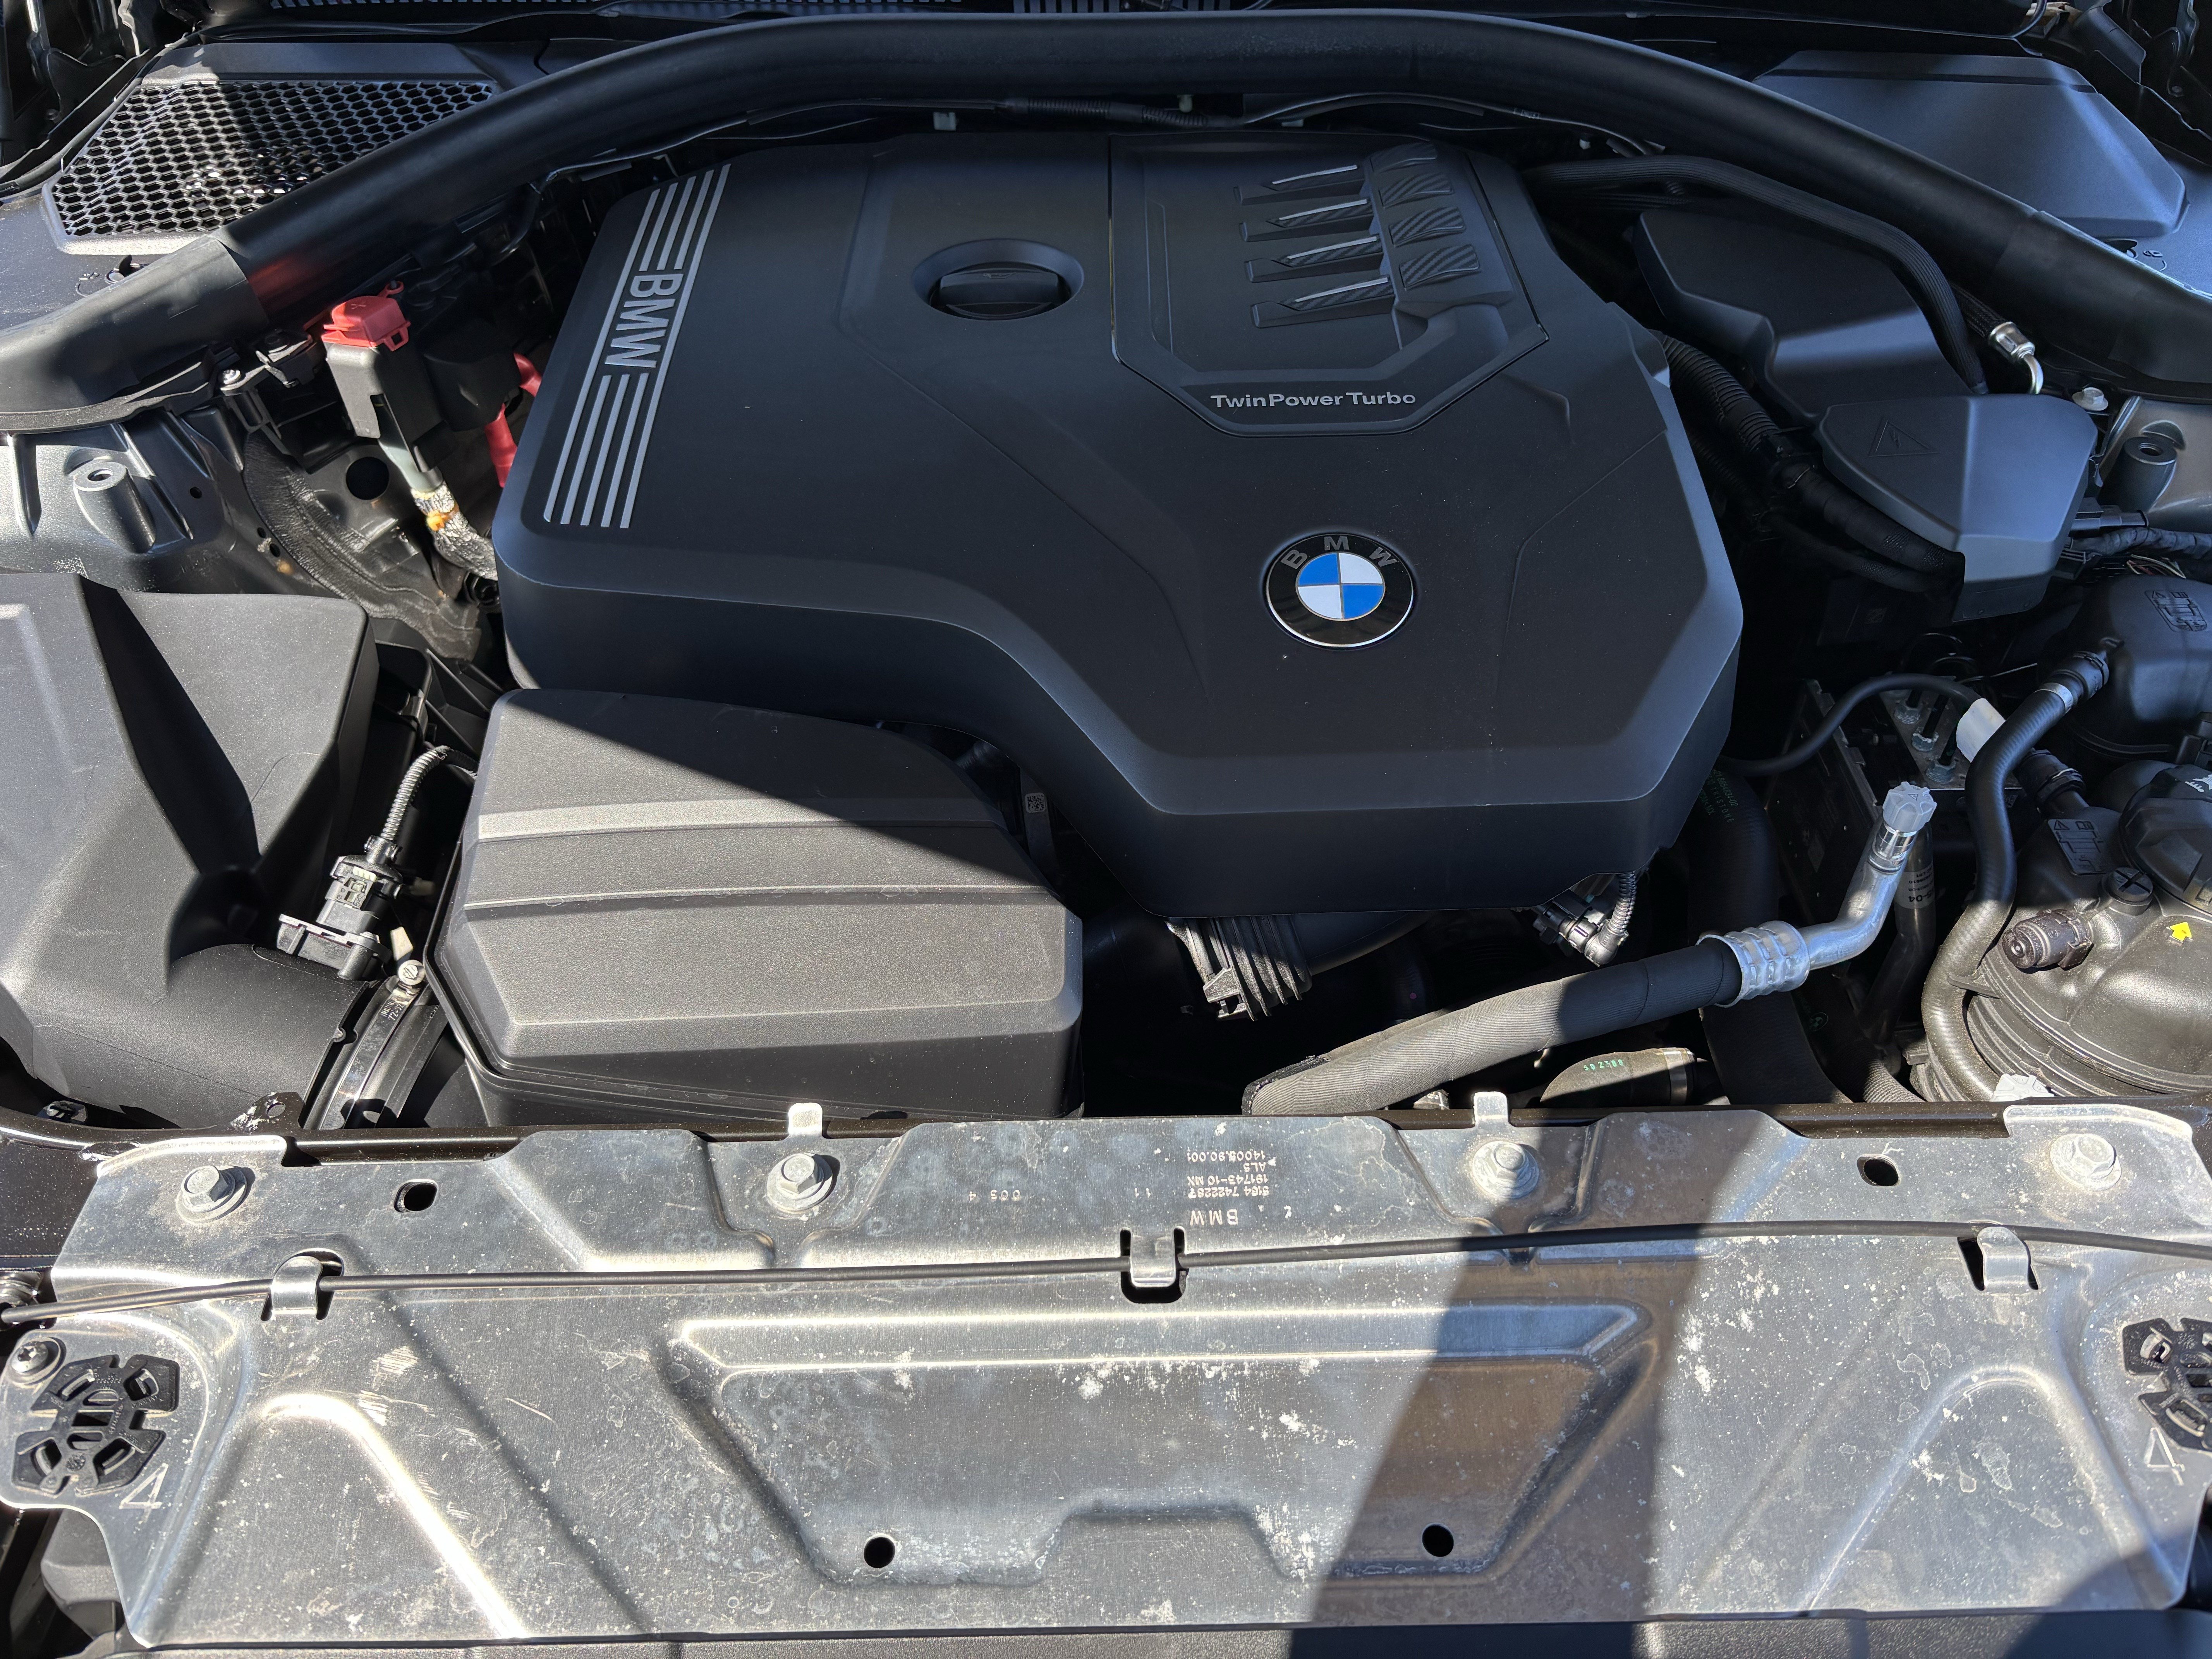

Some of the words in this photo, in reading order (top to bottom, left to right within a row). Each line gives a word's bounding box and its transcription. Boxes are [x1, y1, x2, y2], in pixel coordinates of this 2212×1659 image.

[604, 272, 685, 369] BMW
[1210, 393, 1343, 408] TwinPower
[1345, 391, 1416, 405] Turbo
[1280, 535, 1398, 570] BMW
[1187, 1175, 1204, 1186] MX
[1189, 1209, 1238, 1226] BMW
